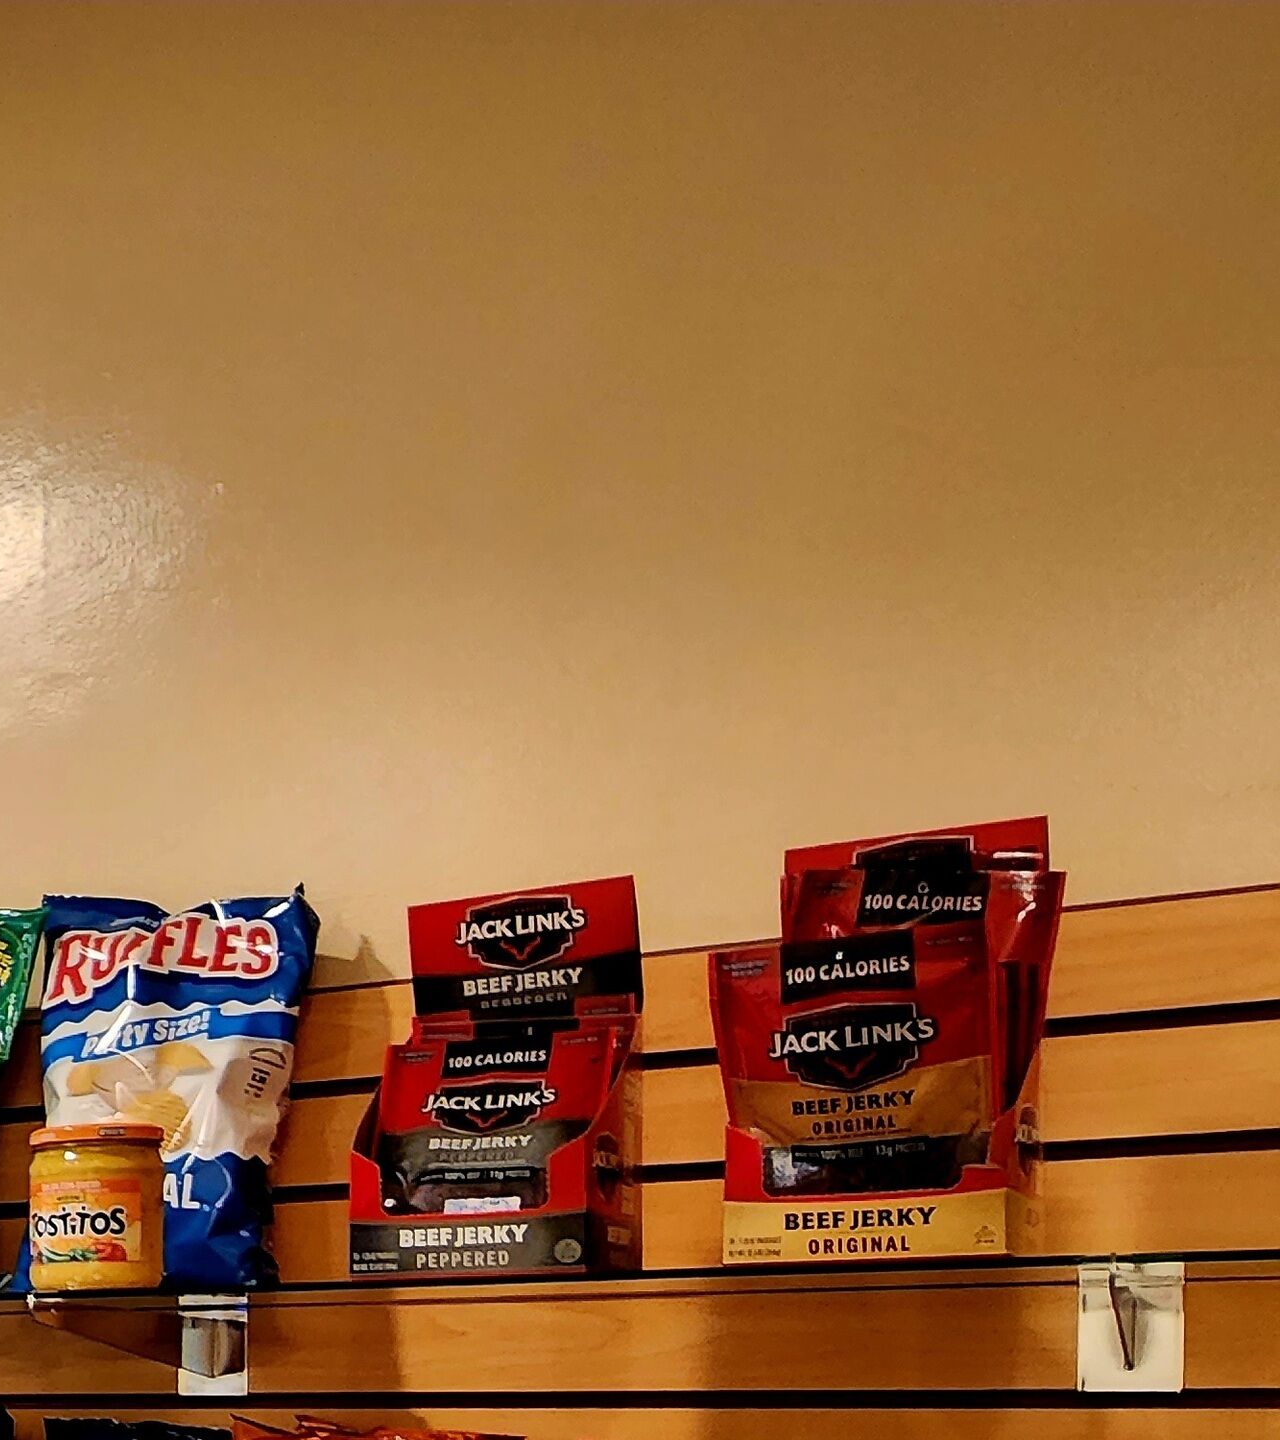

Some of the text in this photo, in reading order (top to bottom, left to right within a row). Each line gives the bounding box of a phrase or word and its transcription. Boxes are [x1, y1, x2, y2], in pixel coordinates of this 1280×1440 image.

[863, 894, 983, 912] 100 CALORIES
[455, 920, 514, 945] JACK
[48, 916, 276, 1001] RUFFLES
[785, 955, 911, 985] 100 CALORIES
[462, 967, 584, 998] BEEF JERKY
[769, 1030, 840, 1058] JACK
[448, 1049, 547, 1069] 100 CALORIES
[421, 1093, 483, 1113] JACK
[792, 1089, 915, 1117] BEEF JERKY
[812, 1114, 897, 1136] ORIGINAL
[428, 1134, 533, 1151] BEEF JERKY
[783, 1207, 938, 1231] BEEF JERKY
[398, 1223, 530, 1248] BEEF JERKY
[808, 1235, 911, 1256] ORIGINAL
[416, 1249, 510, 1269] PEPPERED
